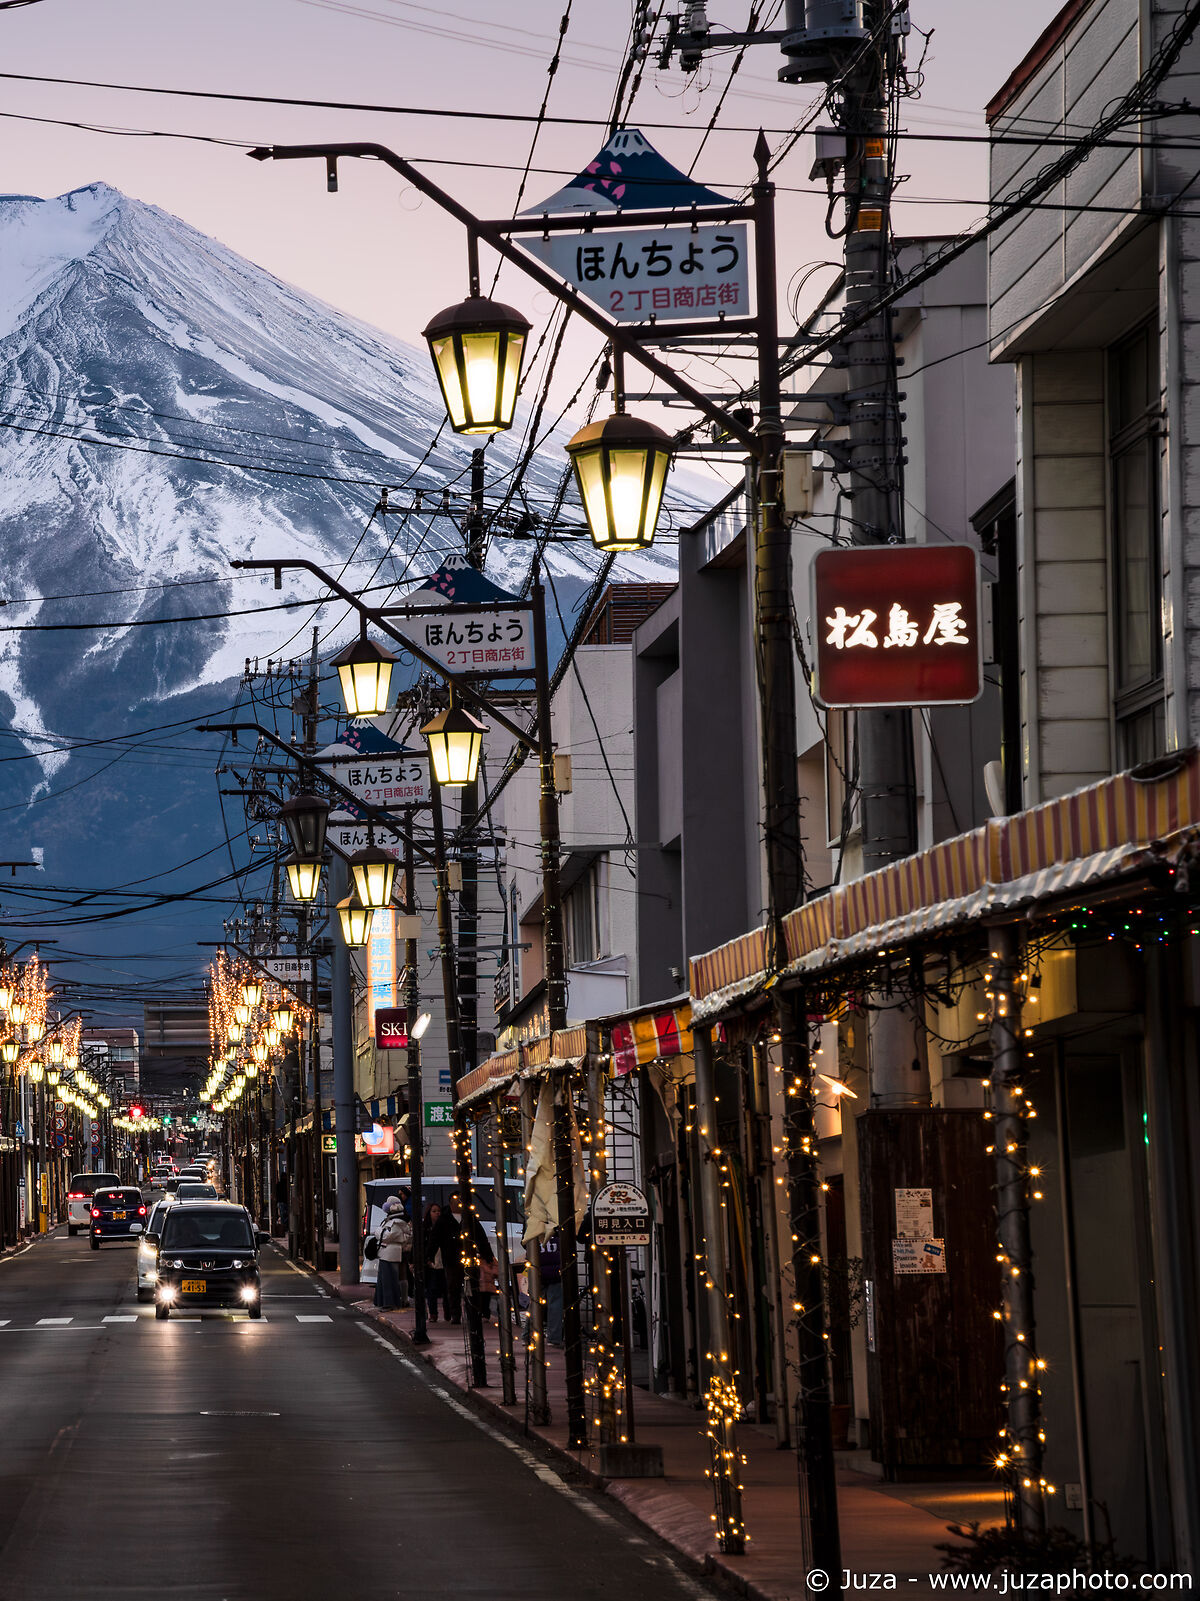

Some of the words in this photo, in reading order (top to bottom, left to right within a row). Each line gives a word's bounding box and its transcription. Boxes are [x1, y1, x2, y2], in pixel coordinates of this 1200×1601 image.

[576, 235, 739, 281] ほんちょう
[610, 282, 739, 312] 2丁目商店街
[425, 618, 524, 646] ほんちょう
[825, 602, 969, 649] 松島屋
[446, 647, 525, 665] 2丁目商店街
[348, 763, 423, 786] ほんちょう
[364, 786, 424, 800] 2丁目商店街
[55, 1102, 63, 1110] 40
[598, 1218, 645, 1229] 明見入口
